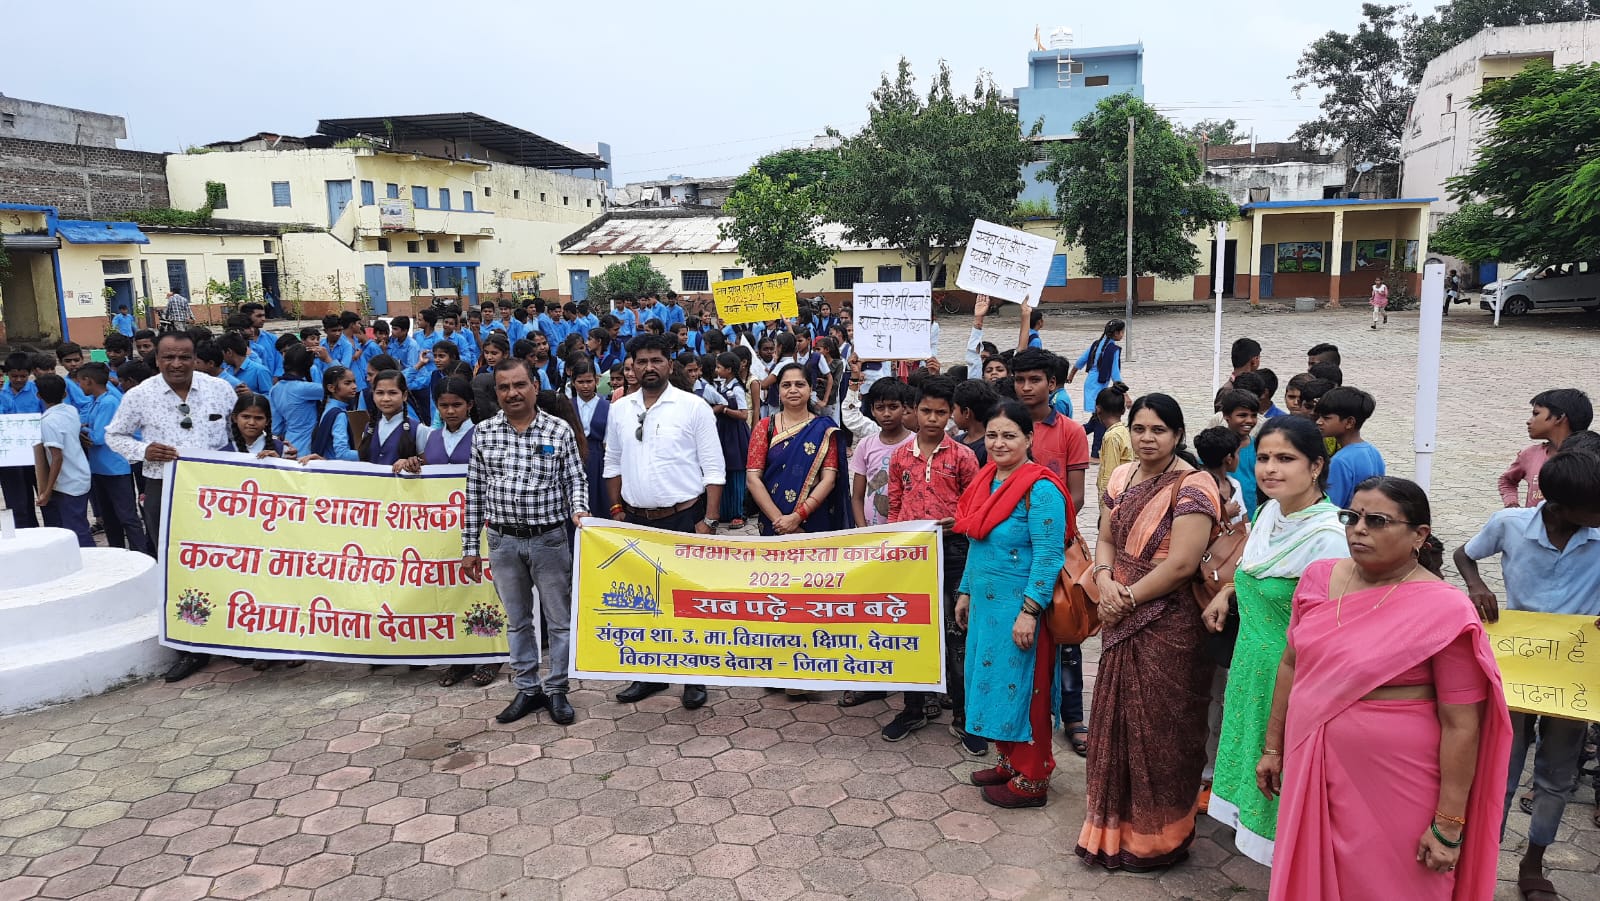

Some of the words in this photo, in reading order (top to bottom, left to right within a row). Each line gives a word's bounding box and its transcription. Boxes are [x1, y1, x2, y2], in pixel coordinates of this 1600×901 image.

[858, 288, 880, 309] नारी
[881, 288, 895, 309] को
[895, 288, 909, 311] भी
[198, 479, 307, 531] एकीकृत
[313, 499, 381, 527] शाला
[385, 491, 467, 531] शासकी
[179, 542, 264, 574] कन्या
[269, 543, 397, 585] माध्यमिक
[674, 544, 757, 562] नवभारत
[761, 547, 840, 564] साक्षरता
[843, 541, 929, 562] कार्यक्रम
[749, 571, 846, 588] 2022-2027
[692, 597, 739, 615] सब
[863, 594, 908, 622] बढ़े
[377, 603, 454, 642] देवास
[595, 623, 646, 647] संकुल
[650, 628, 678, 643] शा.
[683, 630, 699, 644] उ.
[868, 630, 920, 651] देवास
[1567, 629, 1588, 663] है
[619, 647, 721, 669] विकासखण्ड
[725, 651, 773, 671] देवास
[792, 652, 839, 673] जिला
[843, 654, 894, 675] देवास
[1571, 682, 1588, 711] है
